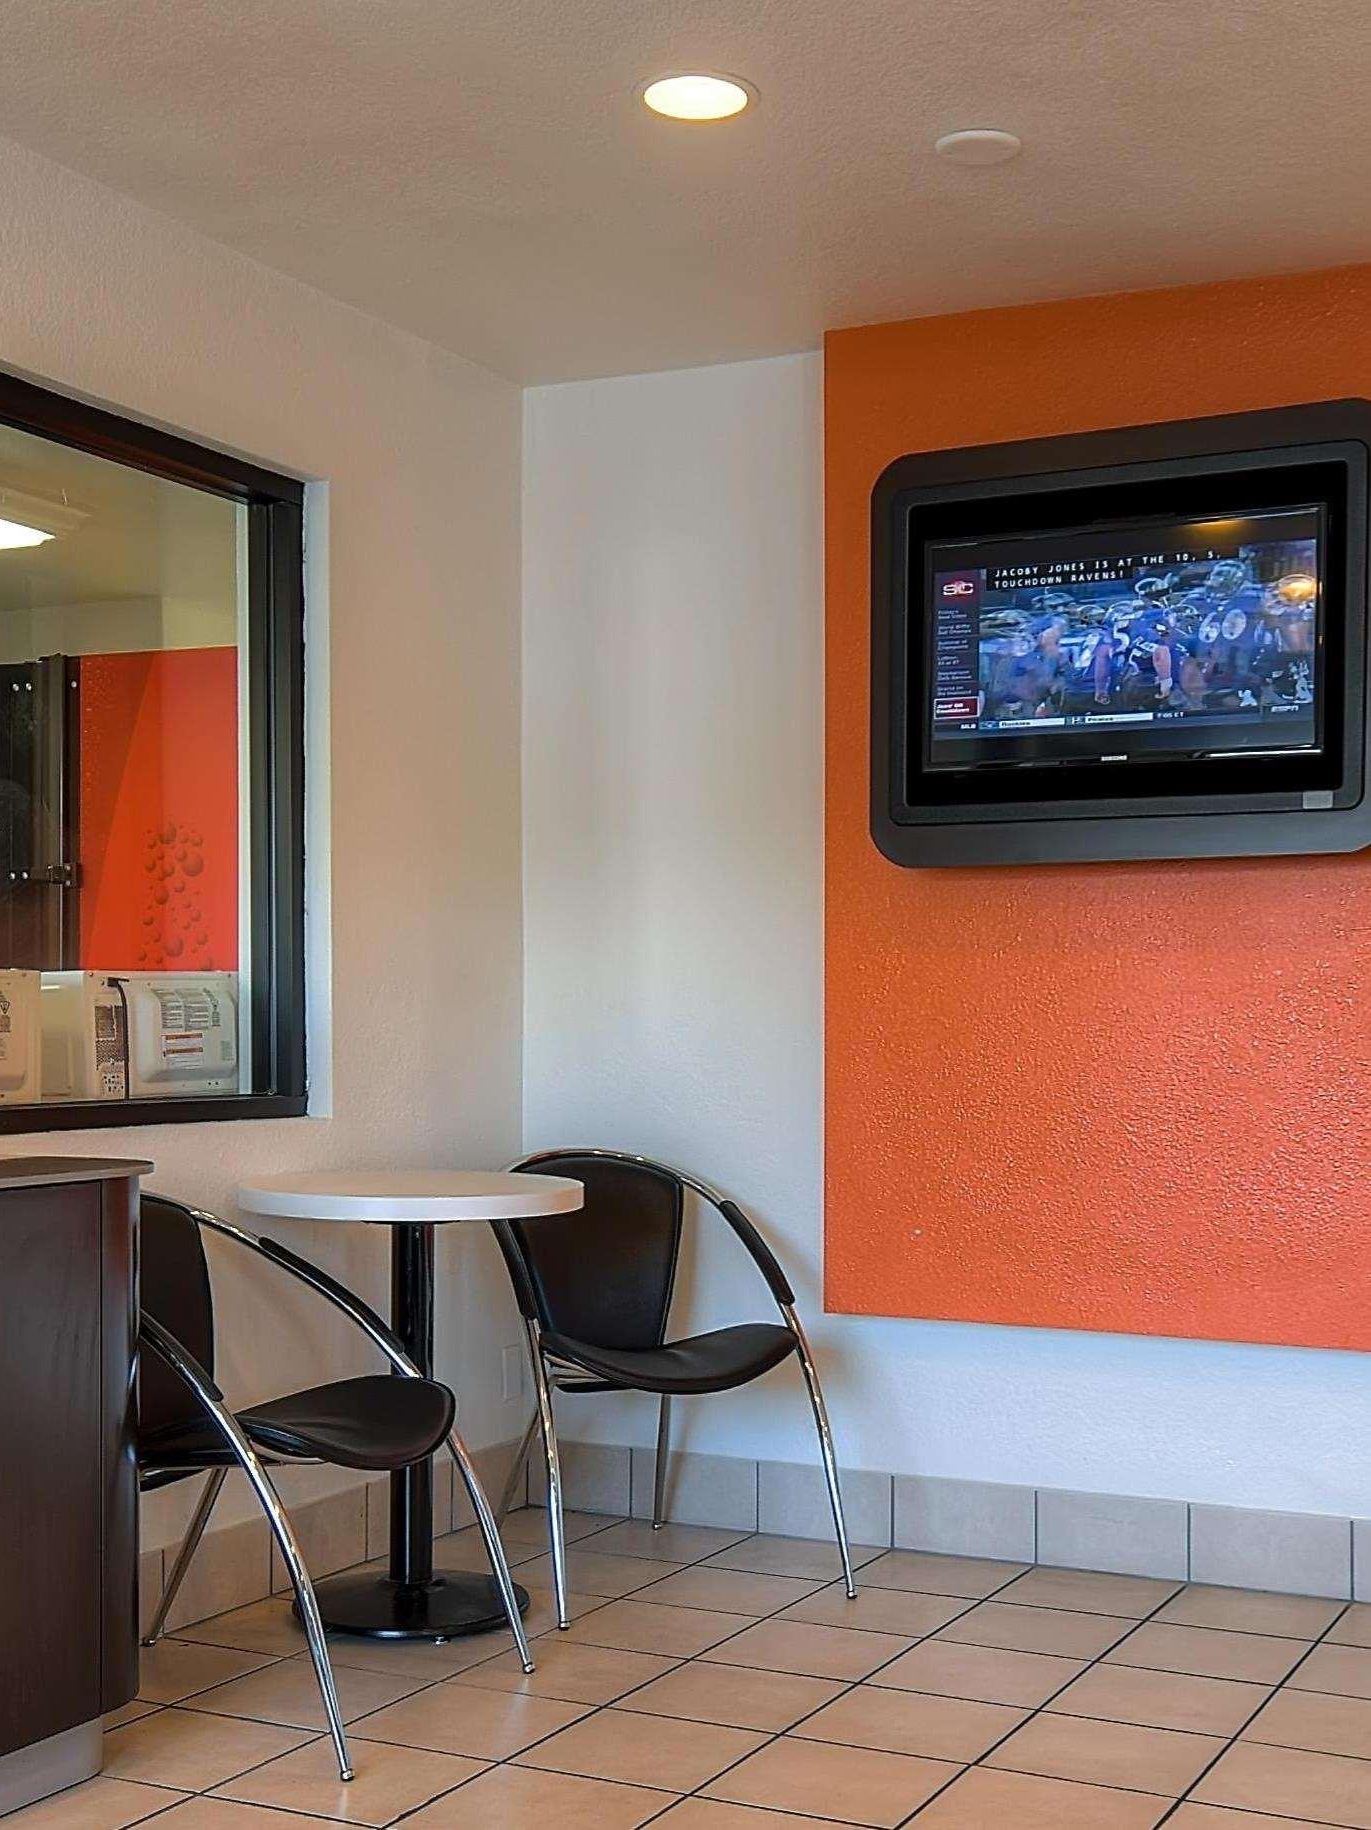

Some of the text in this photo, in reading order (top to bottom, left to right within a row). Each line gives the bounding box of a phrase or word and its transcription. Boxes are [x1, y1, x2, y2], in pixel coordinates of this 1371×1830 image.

[995, 568, 1039, 577] JACOBY
[1049, 562, 1085, 573] JONES
[1095, 560, 1109, 569] IS
[1118, 557, 1132, 567] AT
[1143, 555, 1165, 564] THE
[995, 571, 1125, 588] TOUCHDOWN RAVENS!
